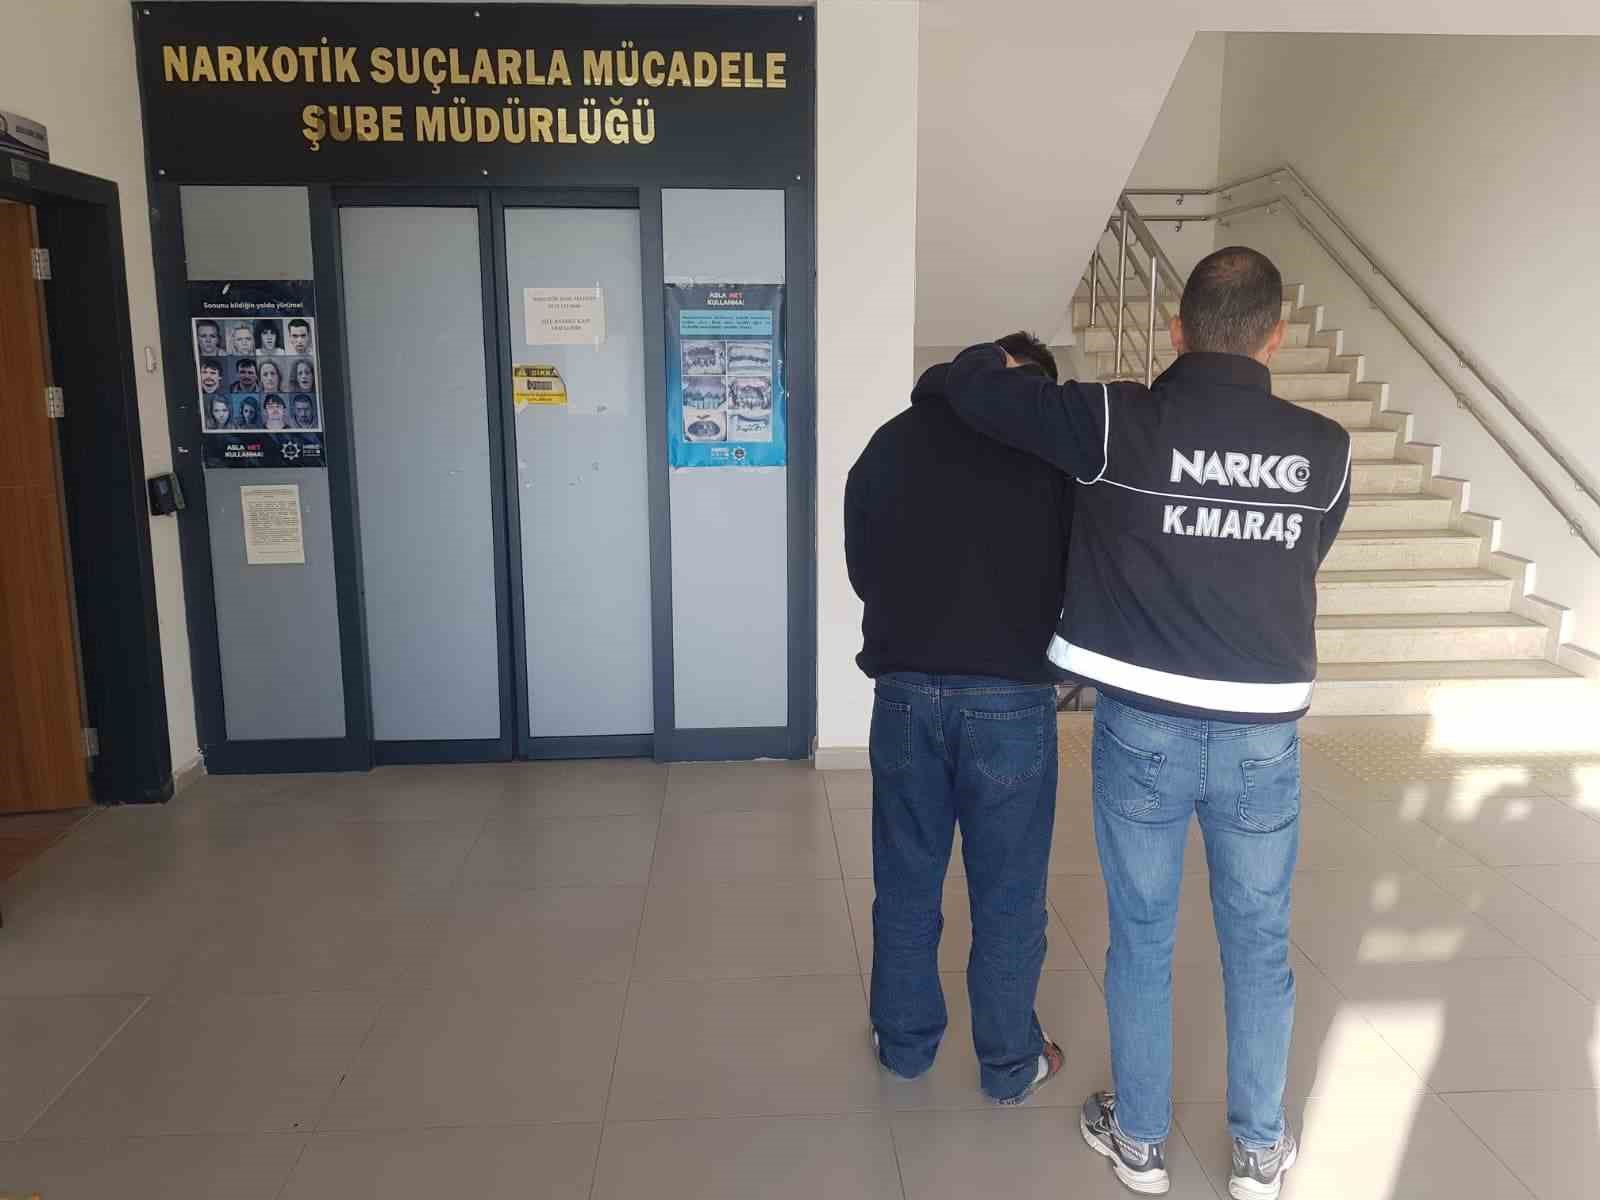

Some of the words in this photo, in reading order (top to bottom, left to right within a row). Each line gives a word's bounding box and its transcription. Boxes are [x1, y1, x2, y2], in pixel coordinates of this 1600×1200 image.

[162, 36, 361, 83] NARKOTİK
[369, 46, 573, 94] SUÇLARLA
[583, 40, 787, 88] MÜCADELE
[302, 104, 405, 151] ŞUBE
[415, 96, 656, 144] MÜDÜRLÜĞÜ
[1163, 504, 1303, 550] K.MARAŞ
